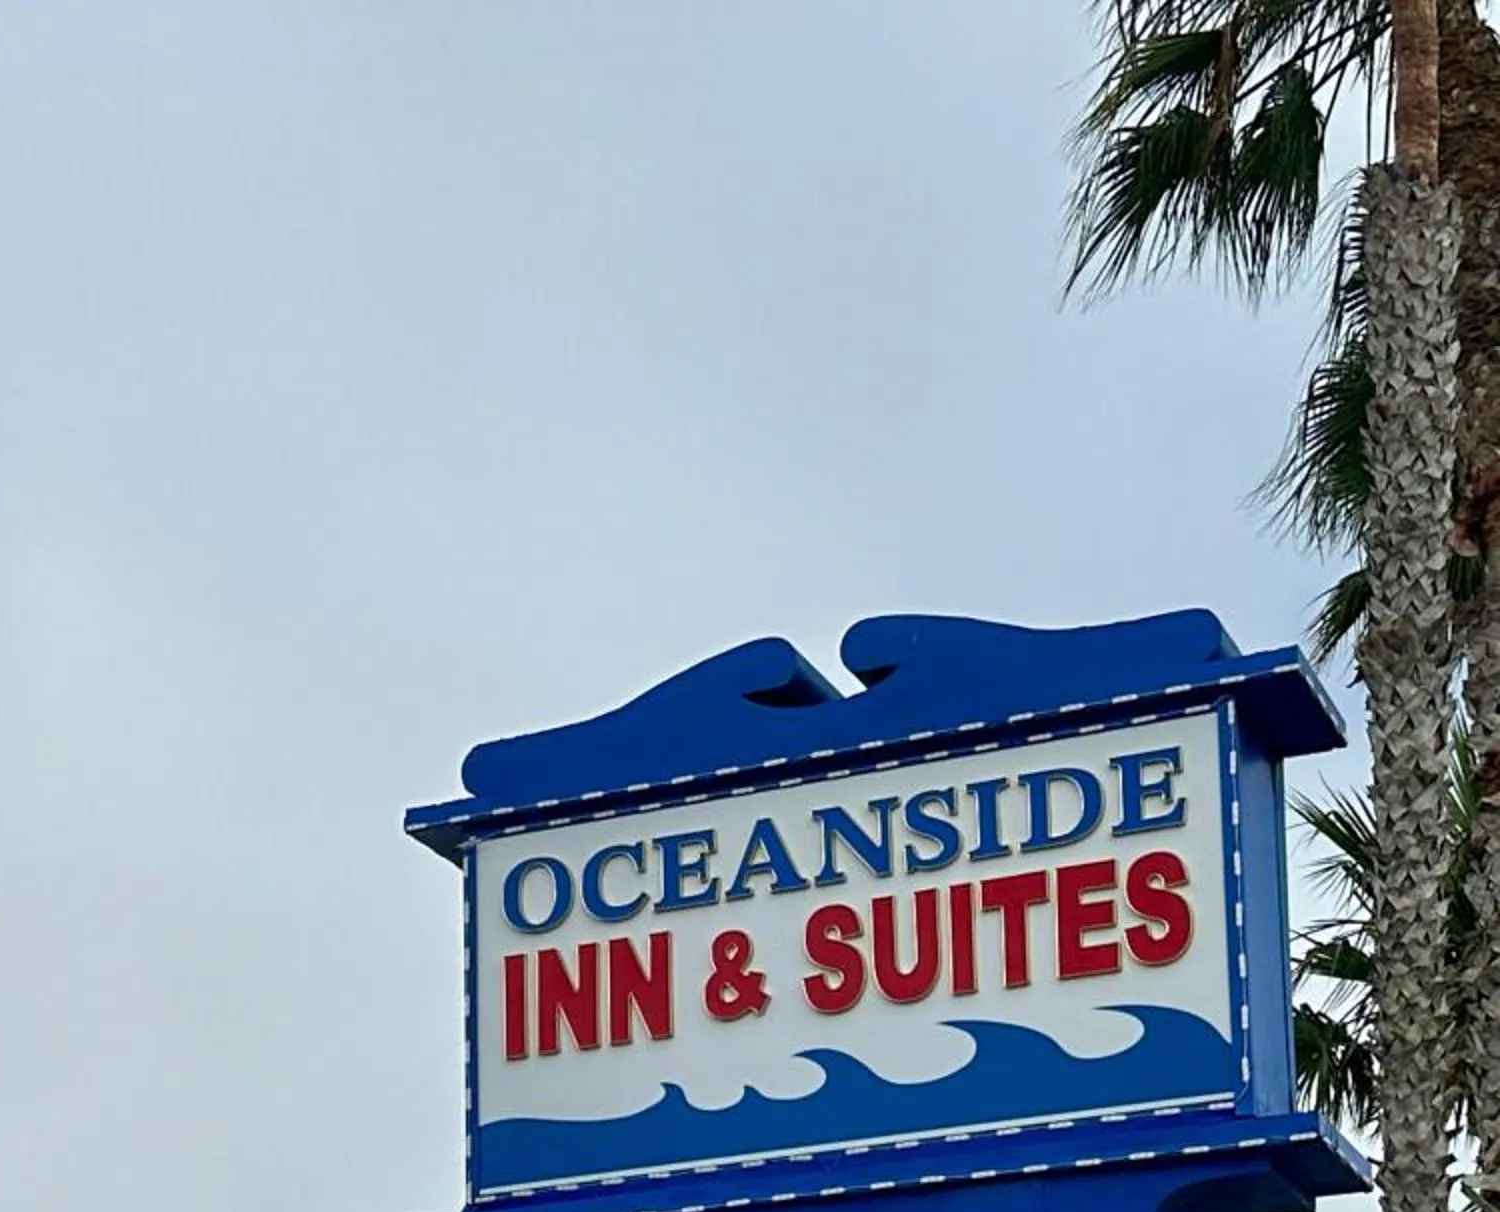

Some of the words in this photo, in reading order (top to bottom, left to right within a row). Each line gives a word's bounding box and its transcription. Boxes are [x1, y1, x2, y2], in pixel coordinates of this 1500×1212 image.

[501, 746, 1187, 935] OCEANSIDE
[503, 931, 673, 1060] INN
[704, 928, 771, 1021] &
[802, 850, 1194, 1014] SUITES
